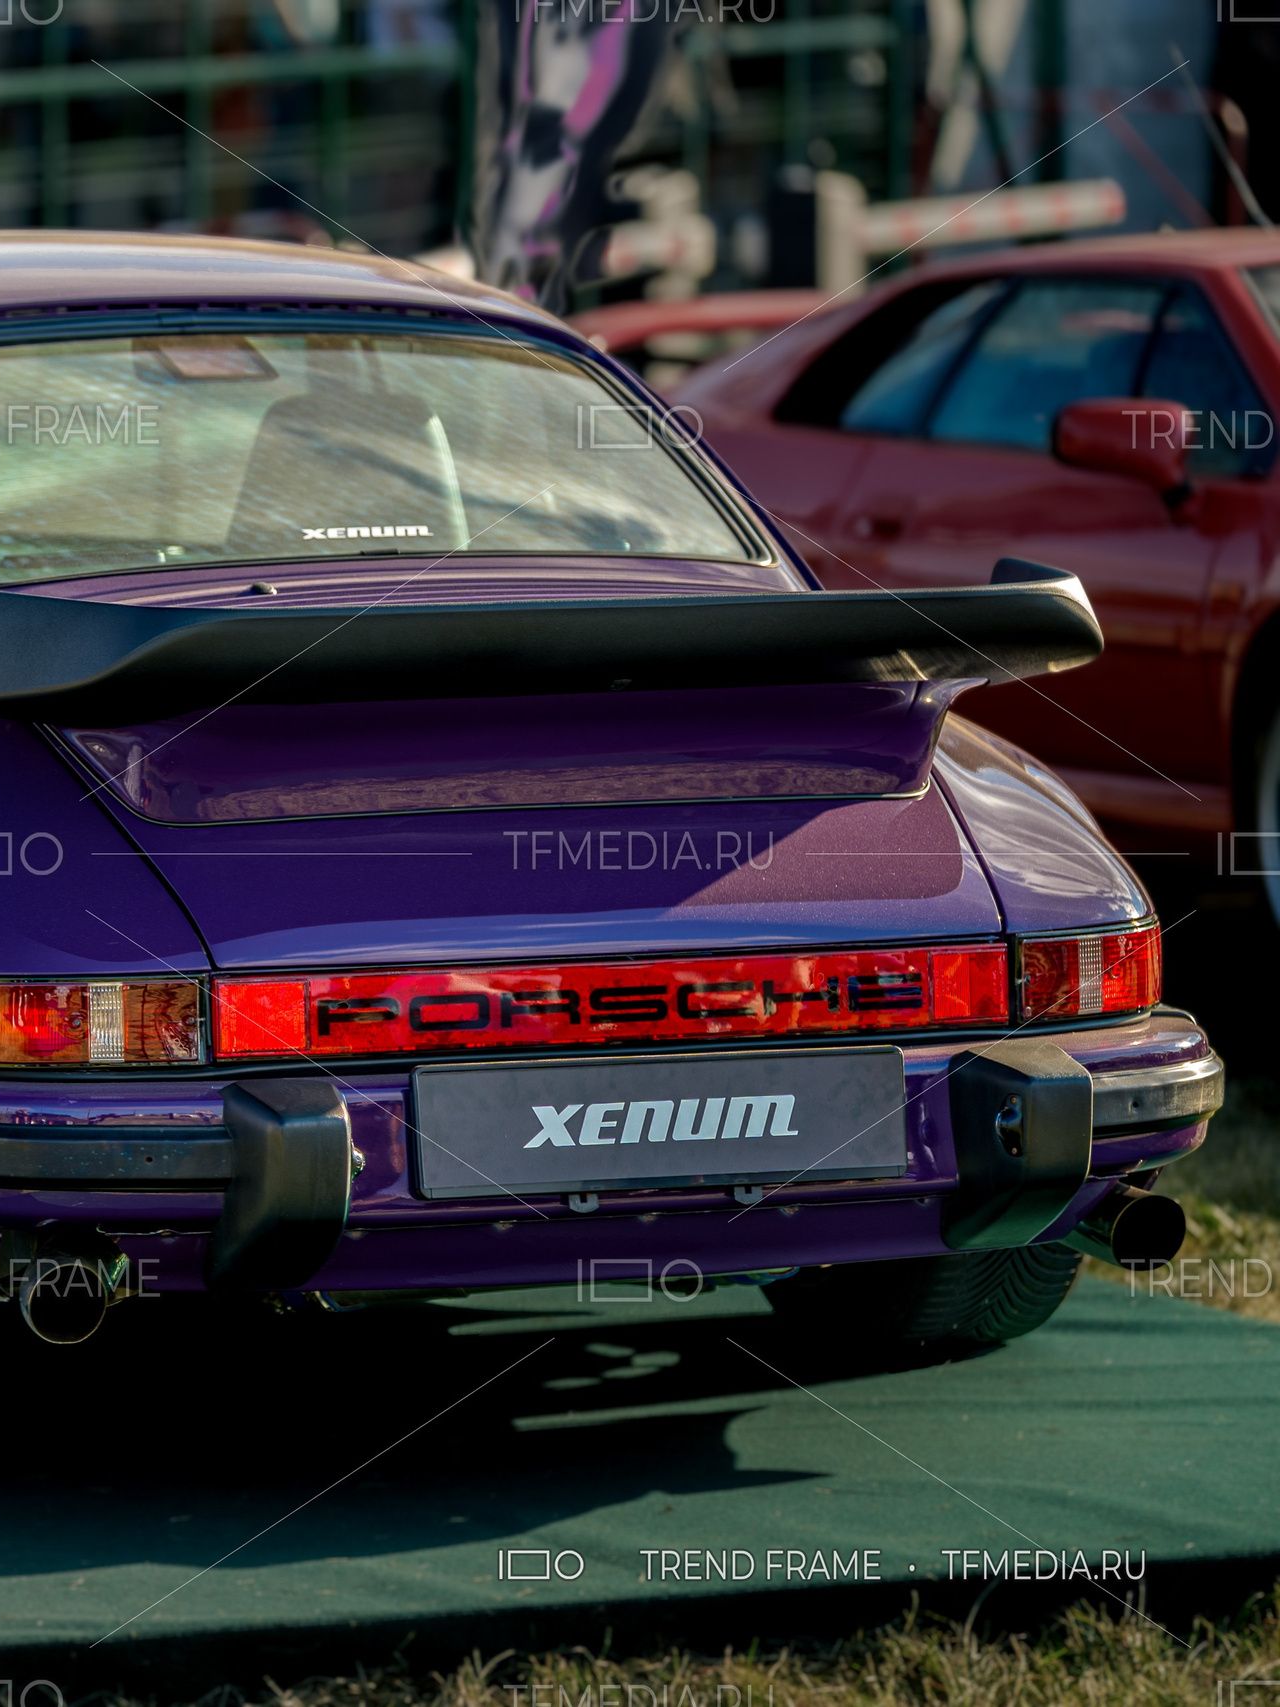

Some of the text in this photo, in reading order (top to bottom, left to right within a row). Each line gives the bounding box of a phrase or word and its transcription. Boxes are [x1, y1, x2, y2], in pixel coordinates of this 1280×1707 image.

[301, 525, 434, 540] XENUM
[319, 972, 922, 1036] PORSCHE
[523, 1094, 798, 1149] XENUM
